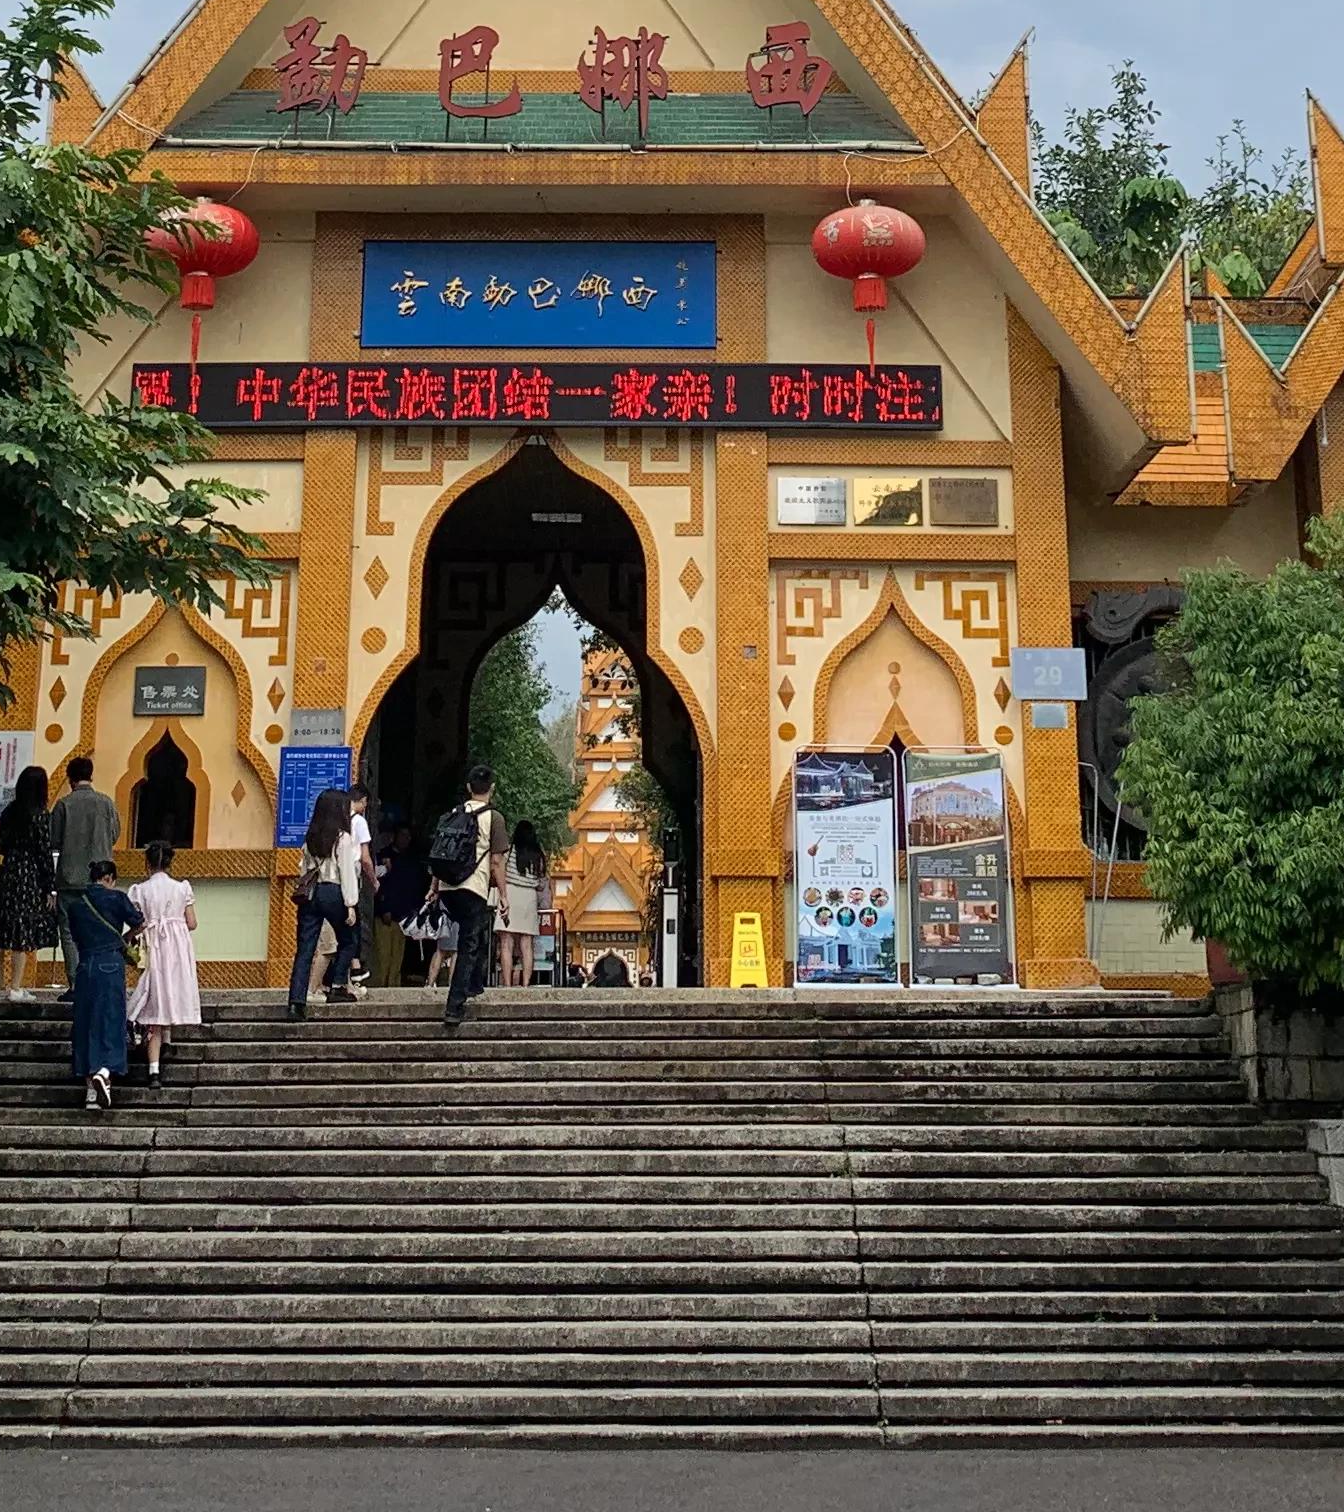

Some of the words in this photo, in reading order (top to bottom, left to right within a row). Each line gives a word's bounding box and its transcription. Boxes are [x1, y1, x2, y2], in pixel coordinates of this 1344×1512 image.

[1033, 665, 1063, 686] 29
[140, 685, 200, 699] 售票处
